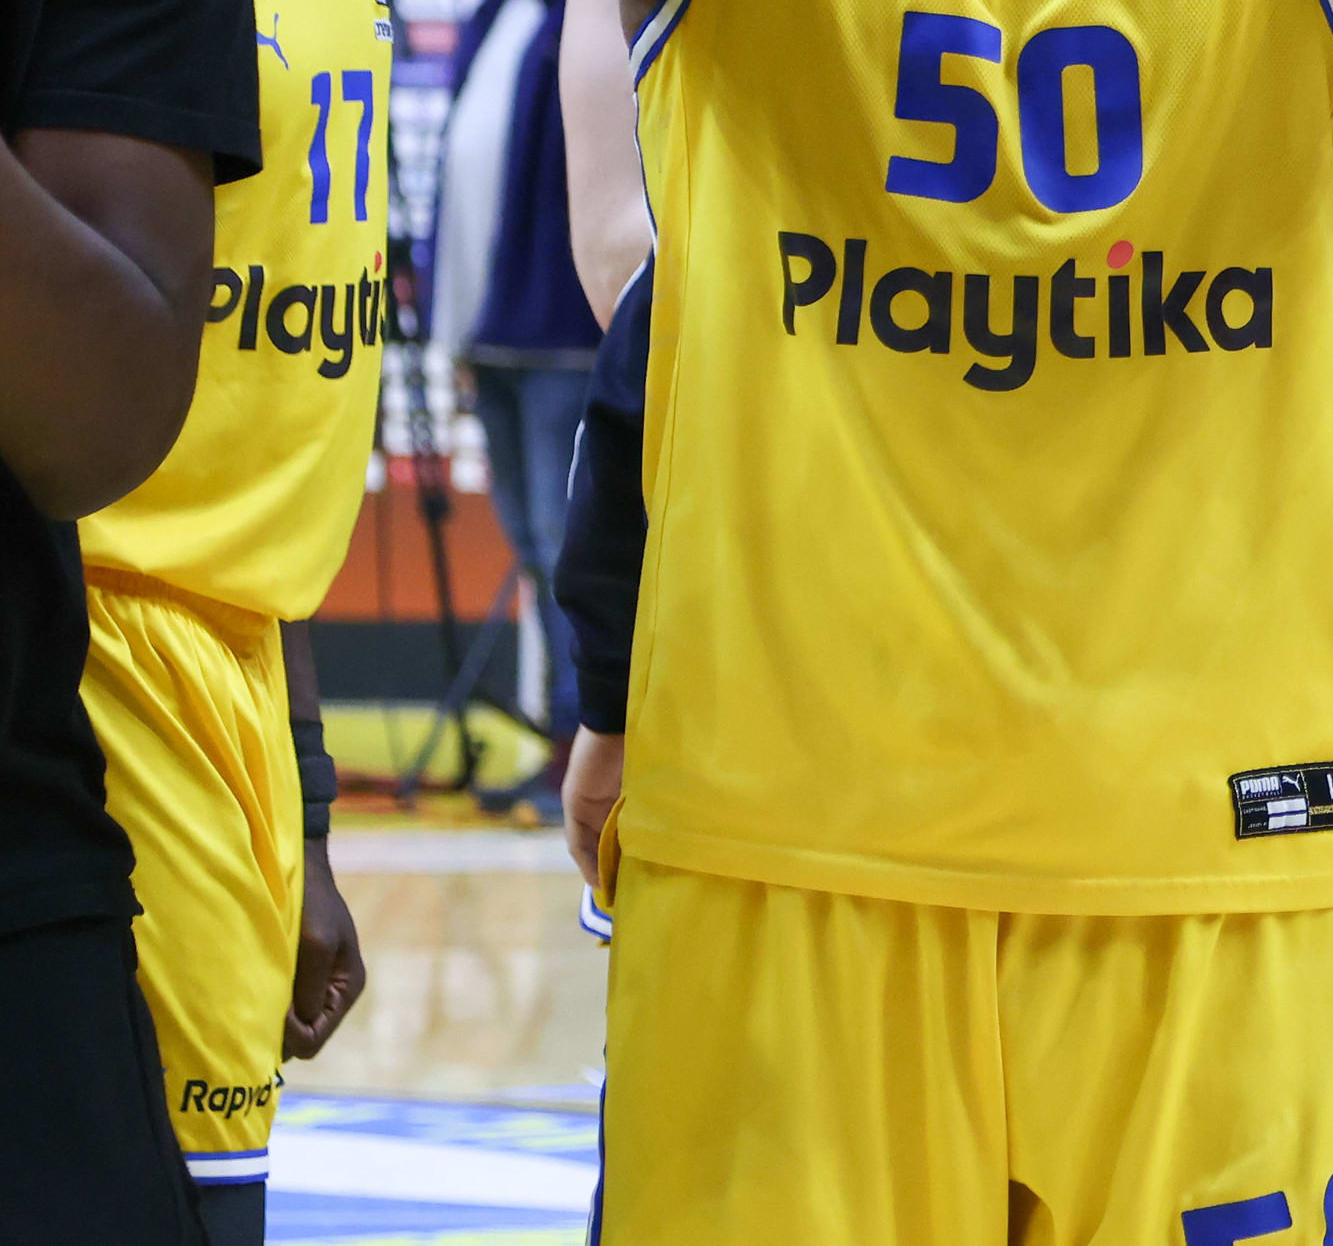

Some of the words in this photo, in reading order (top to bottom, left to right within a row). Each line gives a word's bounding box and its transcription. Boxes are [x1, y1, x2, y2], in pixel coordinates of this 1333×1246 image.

[308, 69, 373, 225] 17
[884, 10, 1144, 215] 50
[205, 250, 387, 379] Playti
[778, 230, 1273, 392] Playtika
[1240, 775, 1281, 795] PUMA
